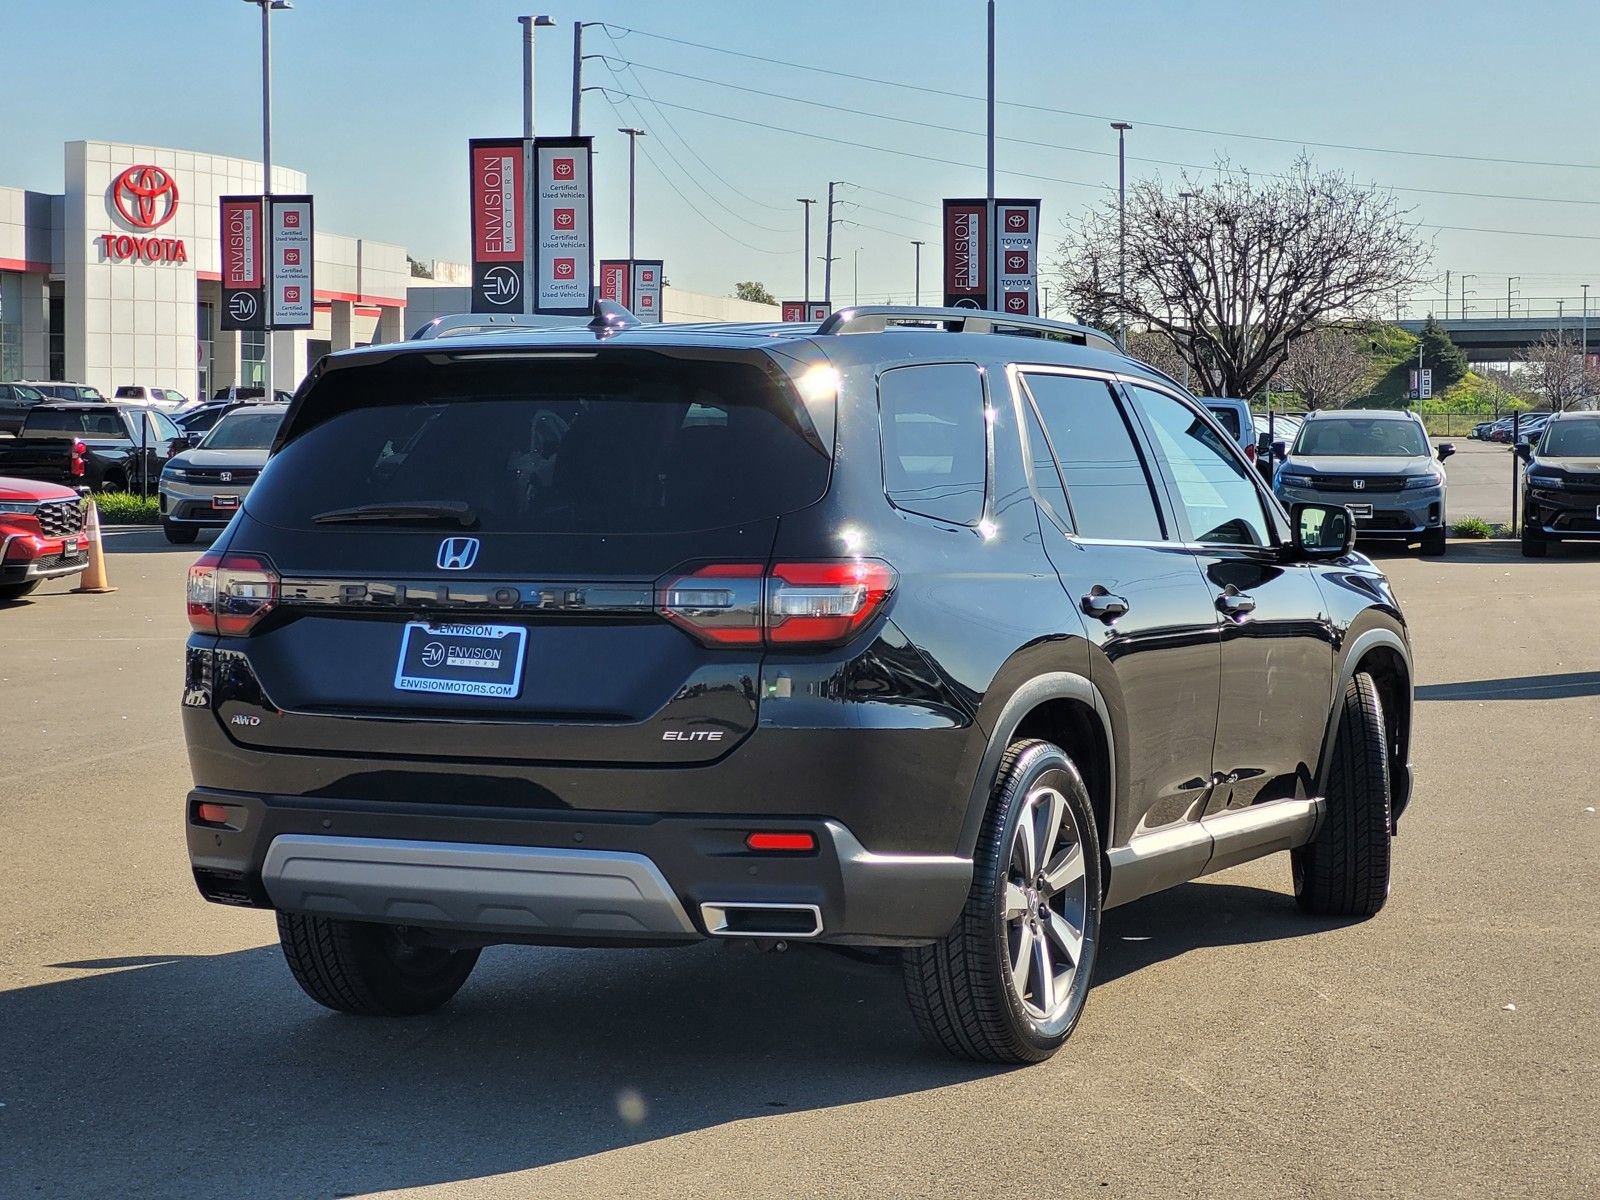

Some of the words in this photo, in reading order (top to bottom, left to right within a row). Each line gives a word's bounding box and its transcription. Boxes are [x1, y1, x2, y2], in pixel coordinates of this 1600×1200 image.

[484, 157, 502, 253] ENVISION
[504, 165, 513, 244] MOTORS
[101, 234, 188, 263] TOYOTA
[230, 209, 244, 282] ENVISION
[954, 213, 969, 288] ENVISION
[606, 268, 616, 299] ISION
[440, 624, 493, 636] ENVISION
[447, 645, 502, 660] ENVISION
[400, 678, 512, 696] ENVISIONMOTORS.COM
[231, 714, 261, 726] AWD
[662, 731, 724, 741] ELITE
